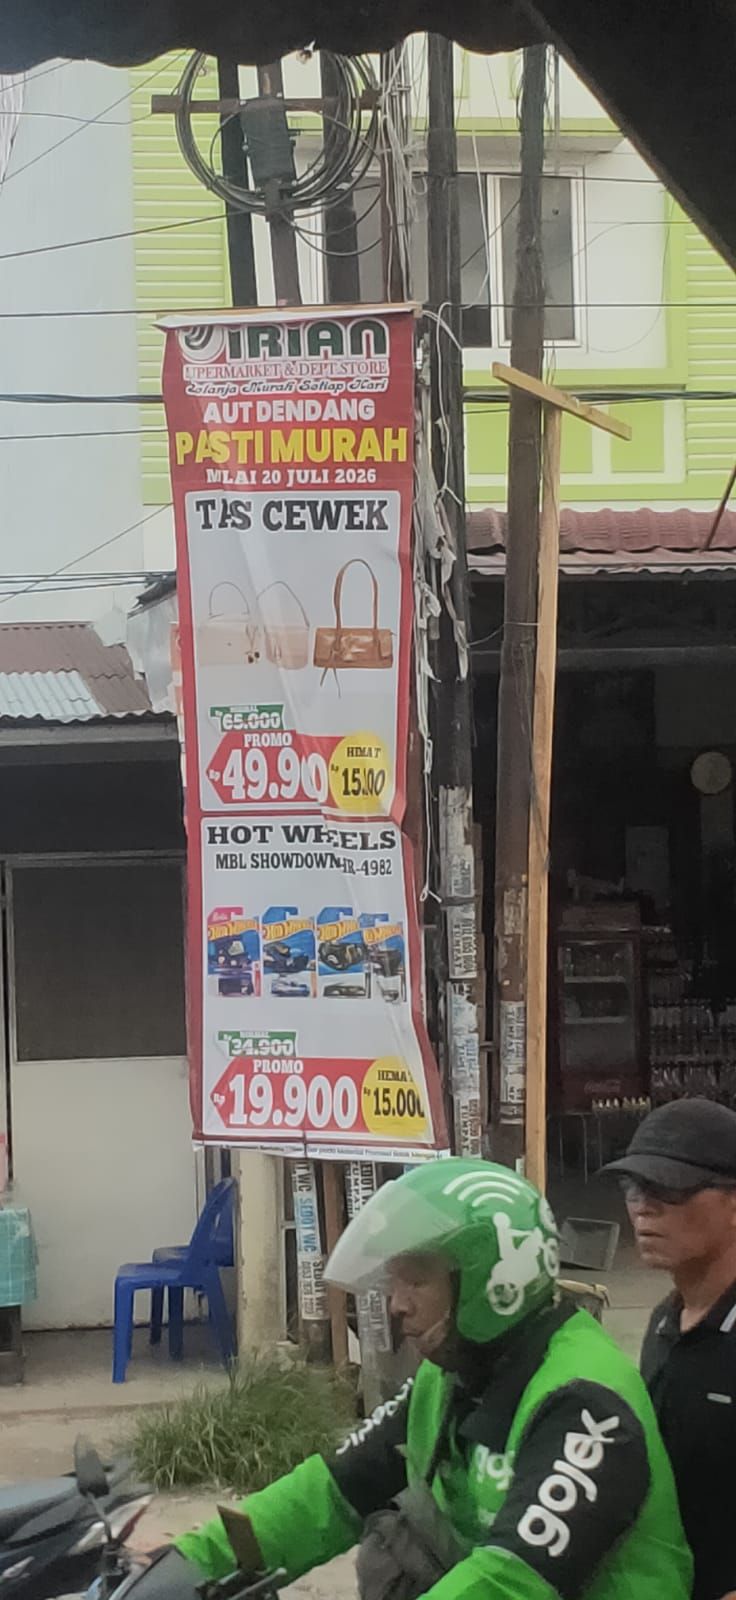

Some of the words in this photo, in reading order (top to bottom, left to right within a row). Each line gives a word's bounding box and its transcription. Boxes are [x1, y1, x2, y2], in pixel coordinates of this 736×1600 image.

[186, 363, 280, 379] UPERMARKET
[284, 362, 295, 376] &
[340, 360, 388, 375] STORE
[203, 402, 253, 423] AUT
[257, 398, 375, 422] DENDANG
[175, 430, 265, 465] PASTI
[270, 427, 408, 464] MURAH
[206, 469, 257, 485] MLAI
[262, 469, 281, 484] 20
[286, 469, 329, 487] JULI
[335, 468, 377, 483] 2026
[262, 500, 388, 532] CEWEK
[222, 711, 281, 730] 65.000
[244, 732, 293, 748] PROMO
[207, 826, 273, 844] HOT
[216, 853, 247, 869] MBL
[251, 852, 341, 869] SHOWDOWN
[231, 1038, 294, 1056] 34.900
[253, 1059, 304, 1074] PROMO
[228, 1073, 358, 1129] 19.900
[297, 1173, 313, 1192] WC
[361, 1163, 373, 1190] EDOT
[299, 1197, 316, 1231] SEDOT
[302, 1232, 318, 1253] WC
[517, 1408, 620, 1558] gojek
